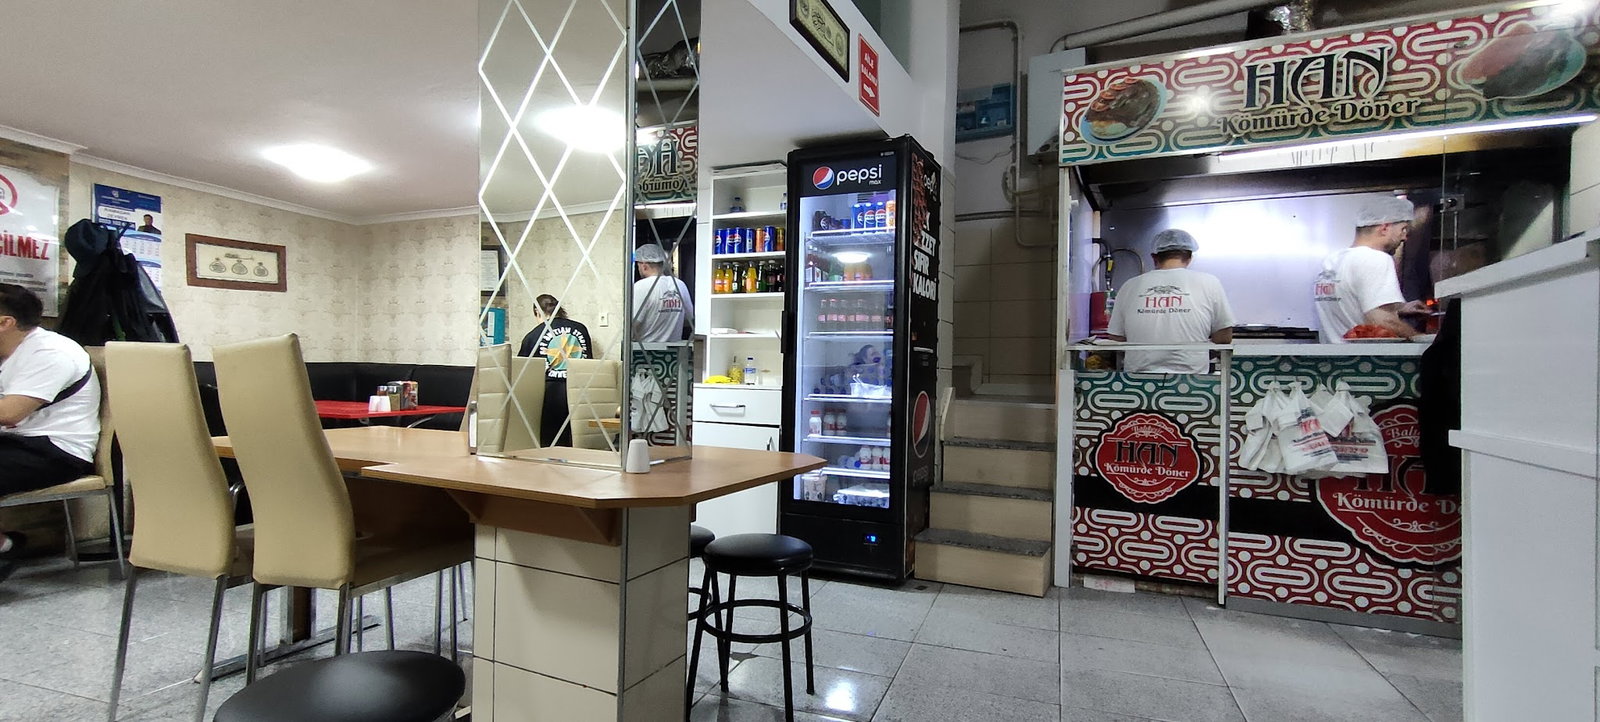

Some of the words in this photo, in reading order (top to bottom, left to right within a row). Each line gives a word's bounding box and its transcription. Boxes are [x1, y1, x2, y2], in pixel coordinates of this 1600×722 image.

[1244, 46, 1393, 108] HAN
[1217, 106, 1330, 135] Kömürde
[1333, 99, 1419, 122] Döner
[836, 164, 883, 186] pepsi
[913, 229, 937, 257] ZZET
[1145, 295, 1183, 308] HAN
[1115, 440, 1179, 468] HAN
[1103, 462, 1153, 475] Kömürde
[1154, 466, 1191, 478] Döner
[1332, 492, 1430, 513] Kömürde
